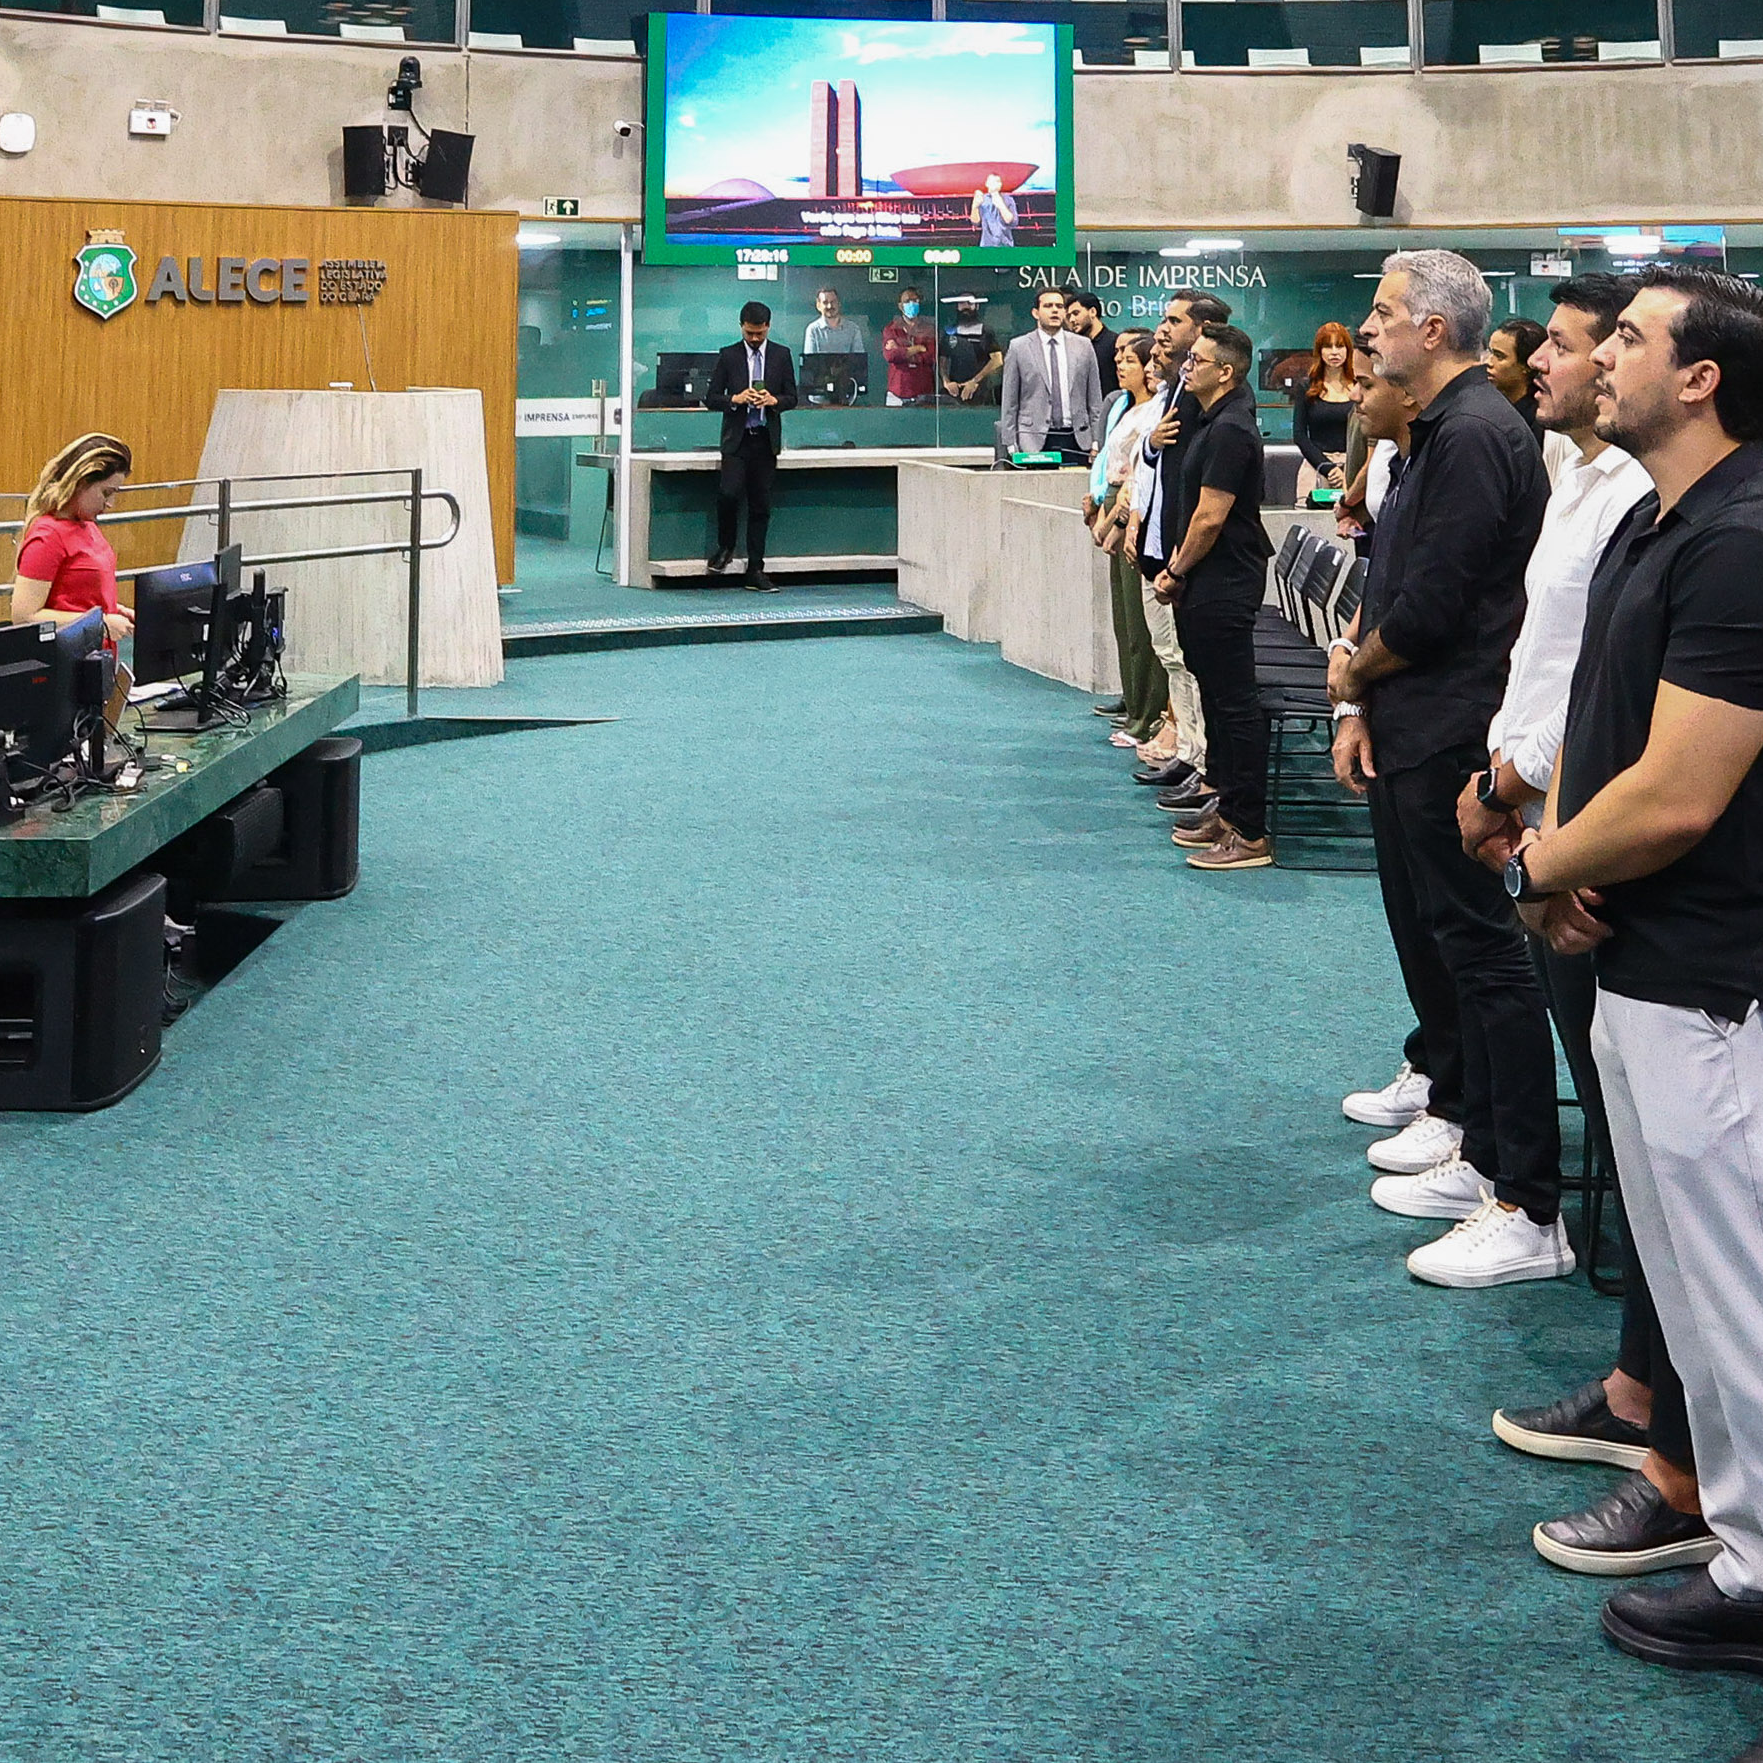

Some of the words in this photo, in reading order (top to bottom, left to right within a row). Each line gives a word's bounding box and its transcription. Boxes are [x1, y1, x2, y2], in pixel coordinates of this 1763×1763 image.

[836, 249, 872, 263] 00:00
[145, 256, 309, 304] ALECE
[320, 269, 387, 280] LEGISLATIVA
[1019, 266, 1082, 288] SALA
[1095, 266, 1127, 288] DE
[1139, 265, 1267, 288] IMPRENSA
[320, 280, 337, 291] DO
[340, 280, 382, 291] ESTADO
[321, 291, 337, 302] DO
[524, 412, 570, 423] IMPRENSA
